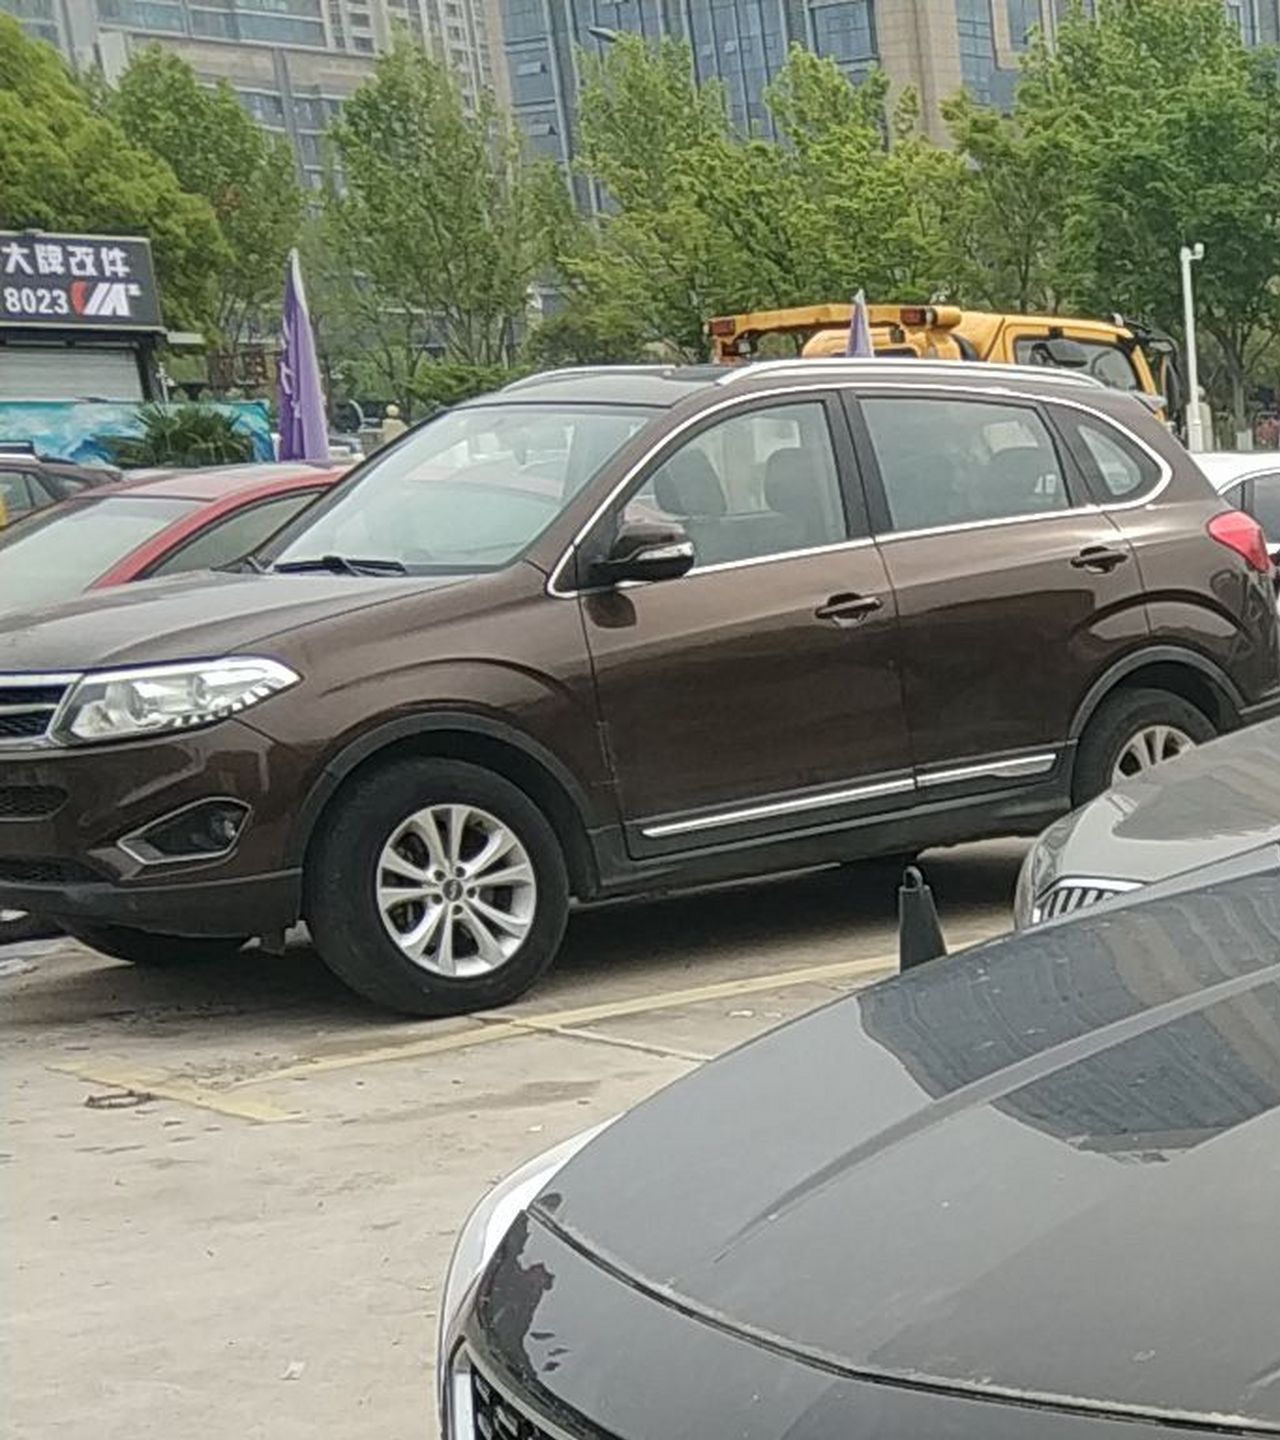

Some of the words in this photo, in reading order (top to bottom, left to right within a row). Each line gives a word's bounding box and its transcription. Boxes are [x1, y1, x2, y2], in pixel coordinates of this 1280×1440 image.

[1, 242, 131, 278] 大牌改件
[3, 286, 70, 315] 8023
